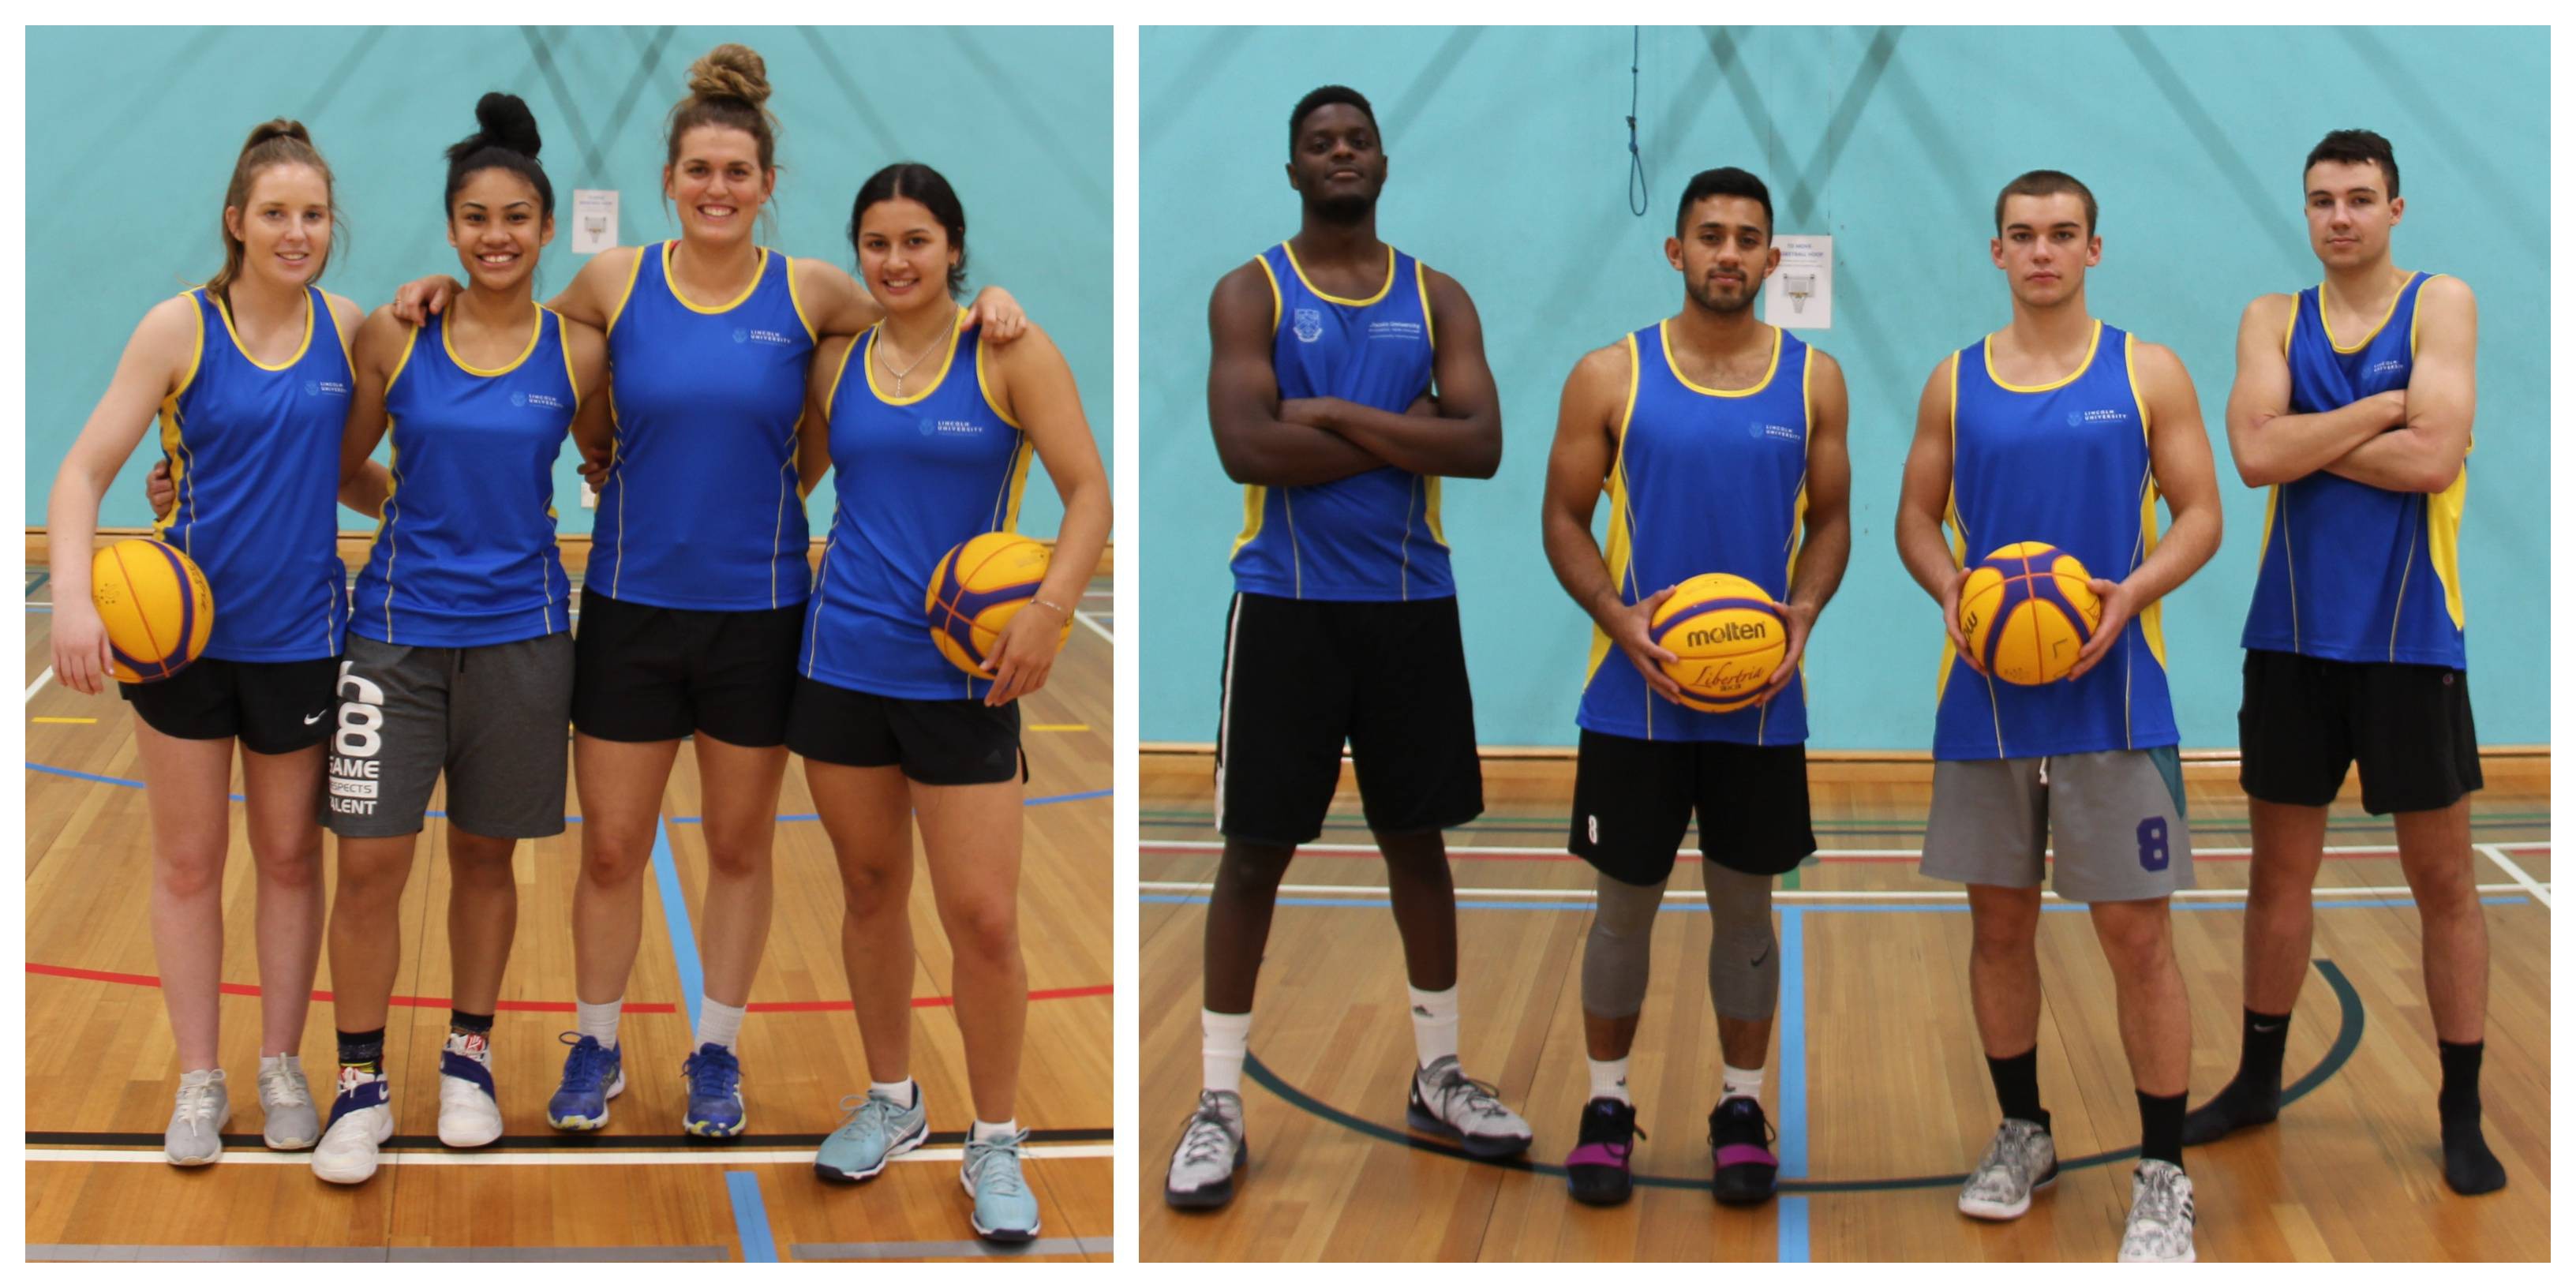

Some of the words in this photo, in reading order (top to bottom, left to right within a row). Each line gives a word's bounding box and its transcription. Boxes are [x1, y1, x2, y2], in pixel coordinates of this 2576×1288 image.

[751, 335, 791, 344] UNIVERSITY
[1687, 622, 1766, 648] molten
[330, 781, 372, 794] SPECTS
[1588, 814, 1597, 844] 8
[2136, 816, 2170, 871] 8
